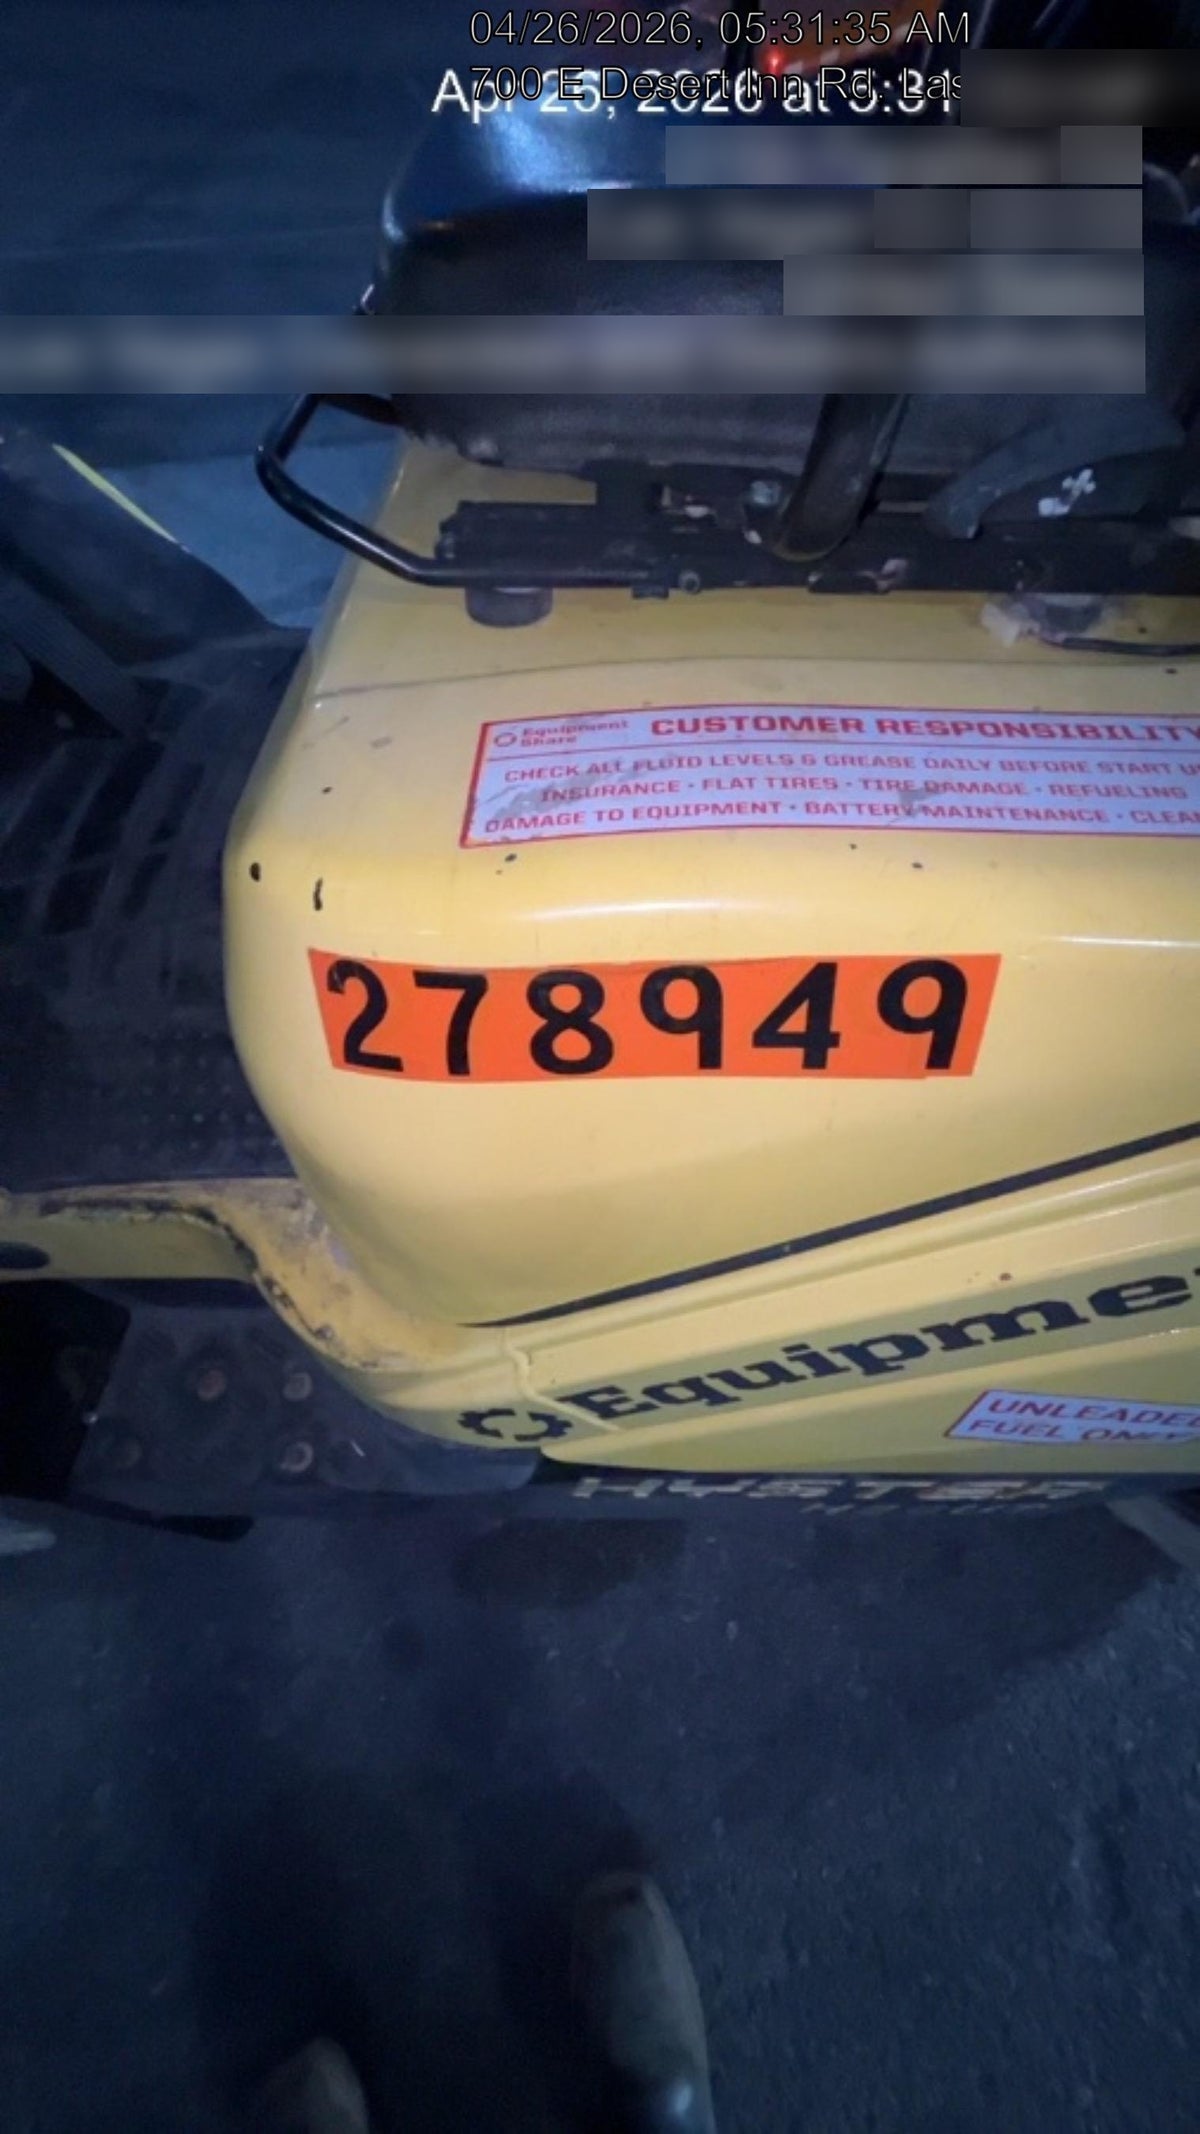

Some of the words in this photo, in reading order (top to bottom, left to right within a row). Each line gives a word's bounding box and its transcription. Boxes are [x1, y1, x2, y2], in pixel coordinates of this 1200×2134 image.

[522, 720, 629, 736] Equipment
[651, 715, 866, 736] CUSTOMER
[520, 734, 577, 747] Share
[504, 764, 580, 783] CHECK
[632, 755, 702, 773] FLUID
[710, 752, 794, 768] LEVELS
[824, 755, 916, 770] GREASE
[923, 756, 992, 772] DAILY
[998, 759, 1091, 775] BEFORE
[1096, 761, 1171, 776] START
[541, 779, 681, 803] INSURANCE
[702, 776, 757, 791] FLAT
[765, 777, 839, 791] TIRES
[857, 778, 916, 793] TIRE
[923, 779, 1029, 797] DAMAGE
[1047, 783, 1188, 800] REFUELING
[484, 811, 587, 834] DAMAGE
[593, 808, 624, 823] TO
[632, 801, 784, 822] EQUIPMENT
[920, 804, 1110, 824] MAINTENANCE
[326, 957, 970, 1077] 278949
[556, 1267, 1200, 1422] Equipme
[969, 1419, 1066, 1438] FUEL
